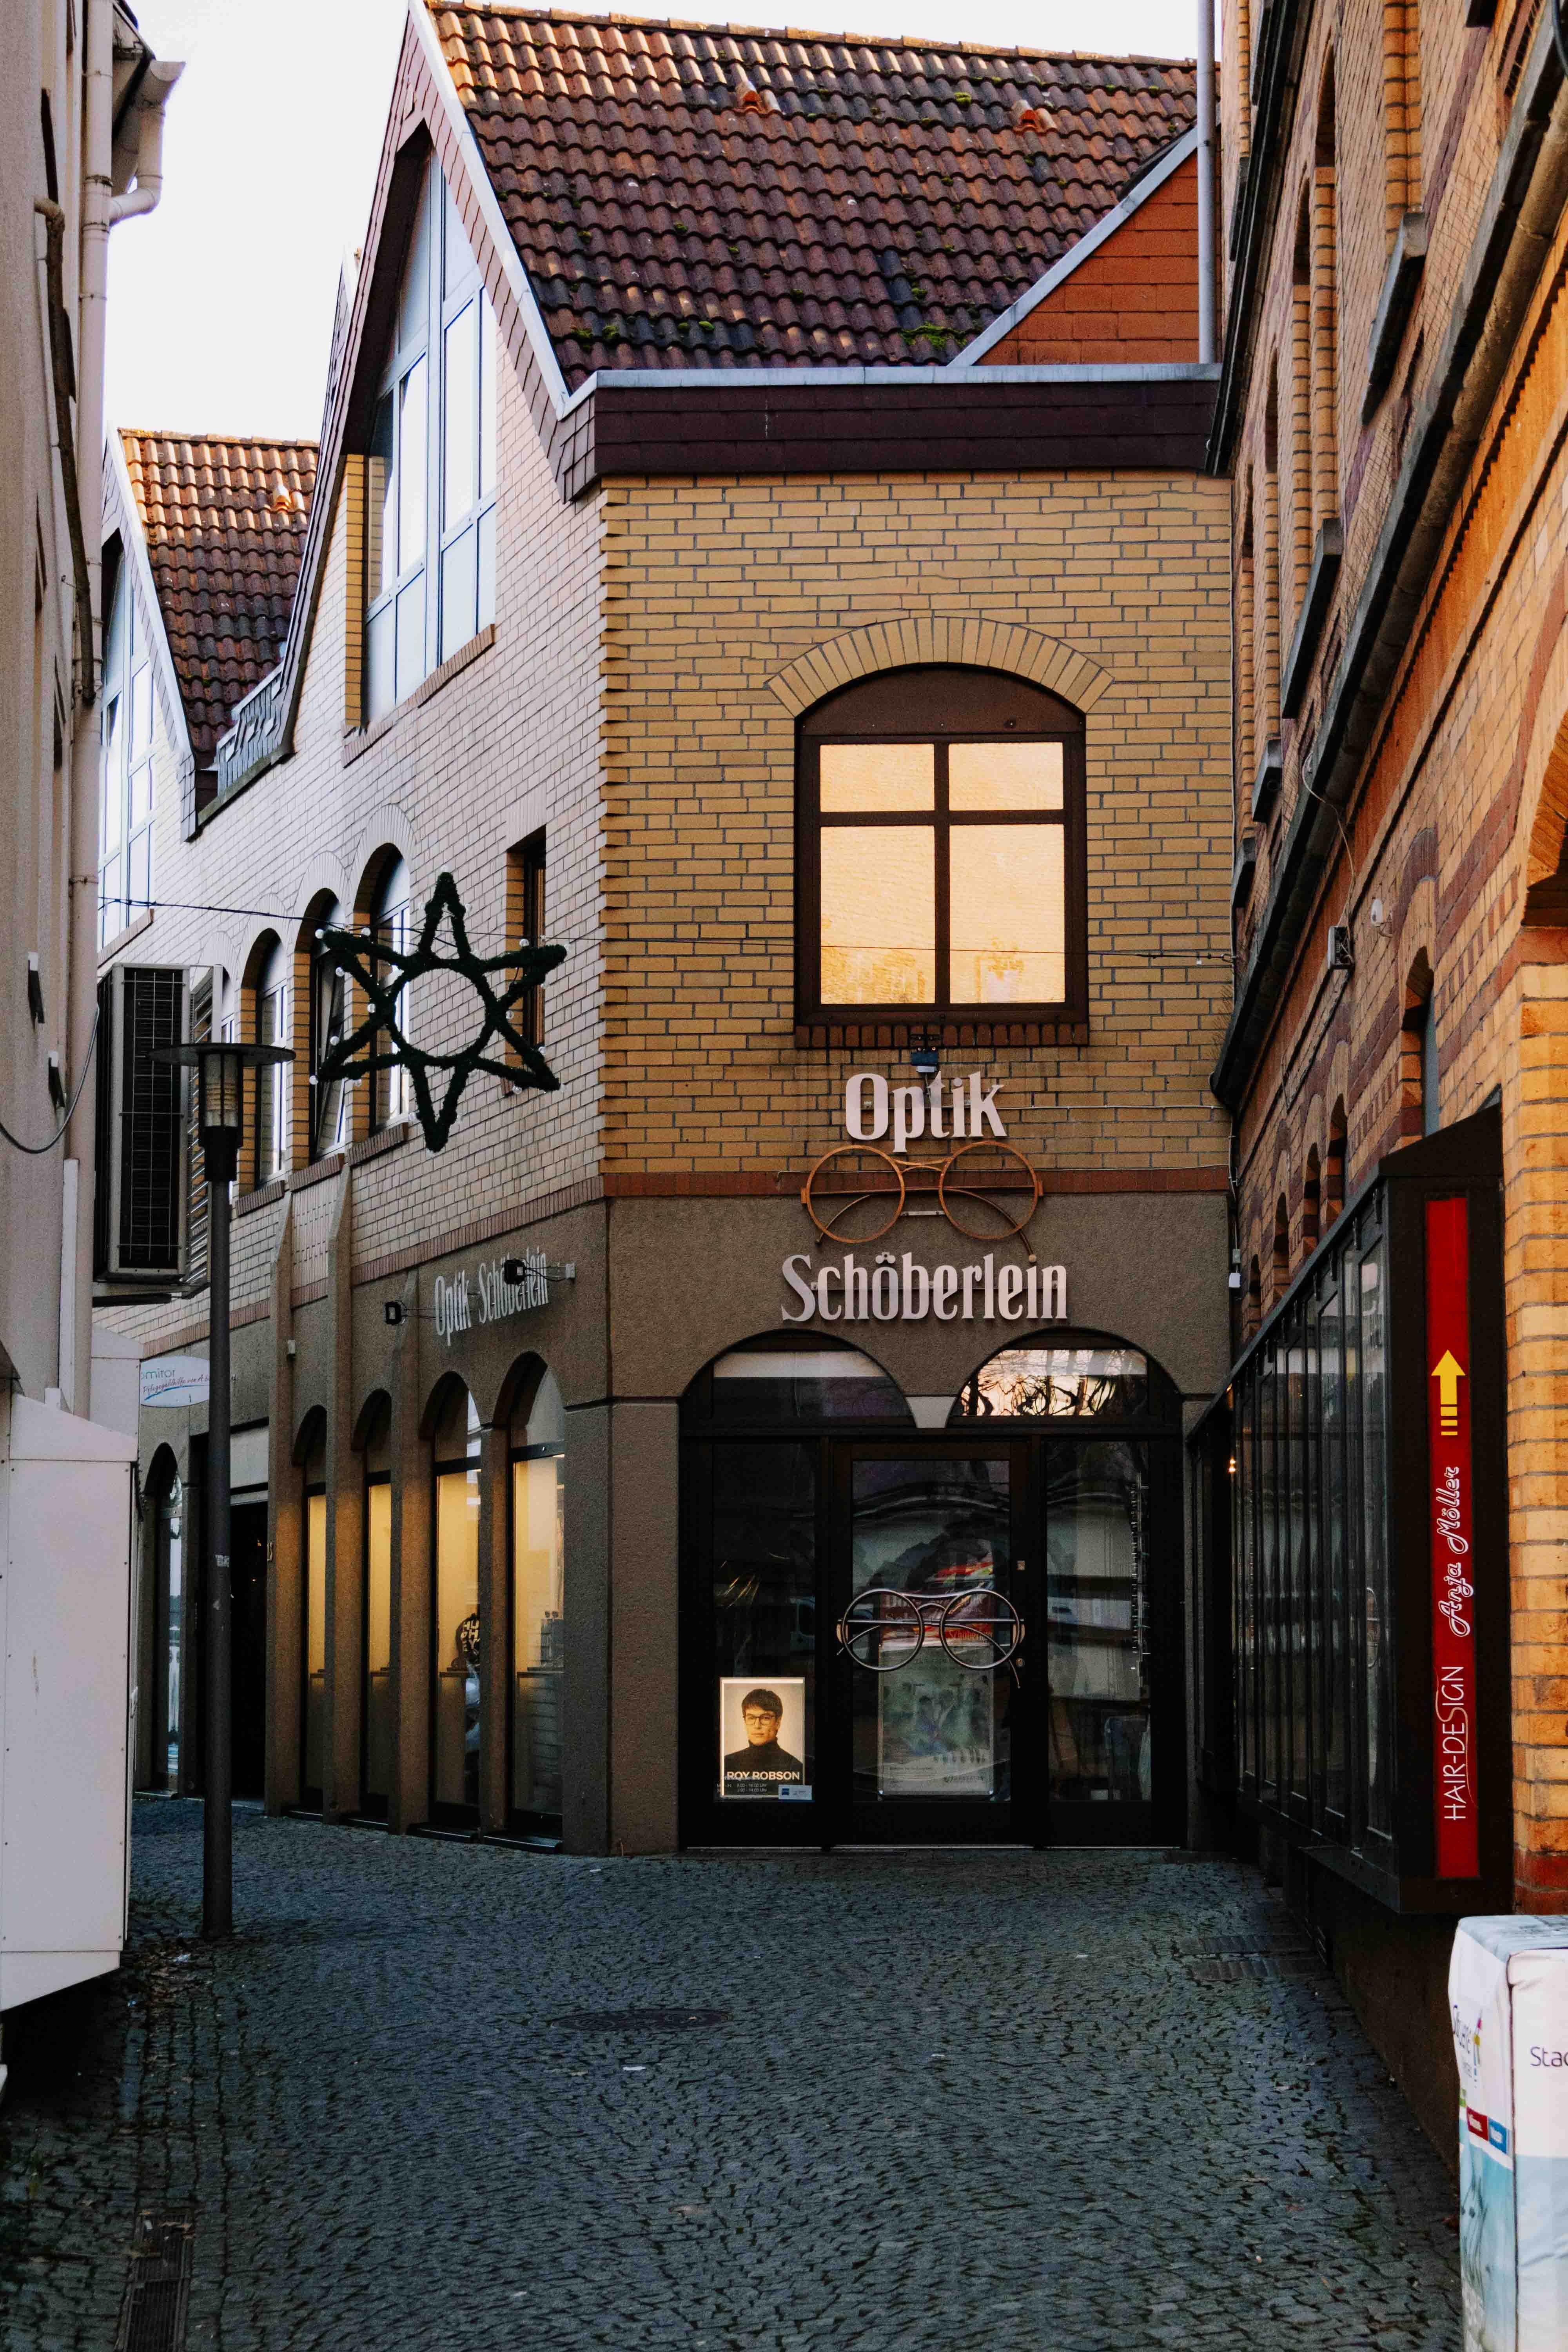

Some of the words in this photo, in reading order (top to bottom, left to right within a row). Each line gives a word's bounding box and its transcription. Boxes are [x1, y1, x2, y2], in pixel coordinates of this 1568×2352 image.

[846, 1070, 1007, 1153] Optik
[434, 1270, 472, 1346] Optik
[781, 1252, 1068, 1322] Schöberlein
[1436, 1466, 1469, 1555] Möller
[1438, 1561, 1474, 1637] Anja
[727, 1771, 750, 1780] ROY
[752, 1771, 800, 1780] ROBSON
[1436, 1666, 1468, 1820] HAIR-DESIGN
